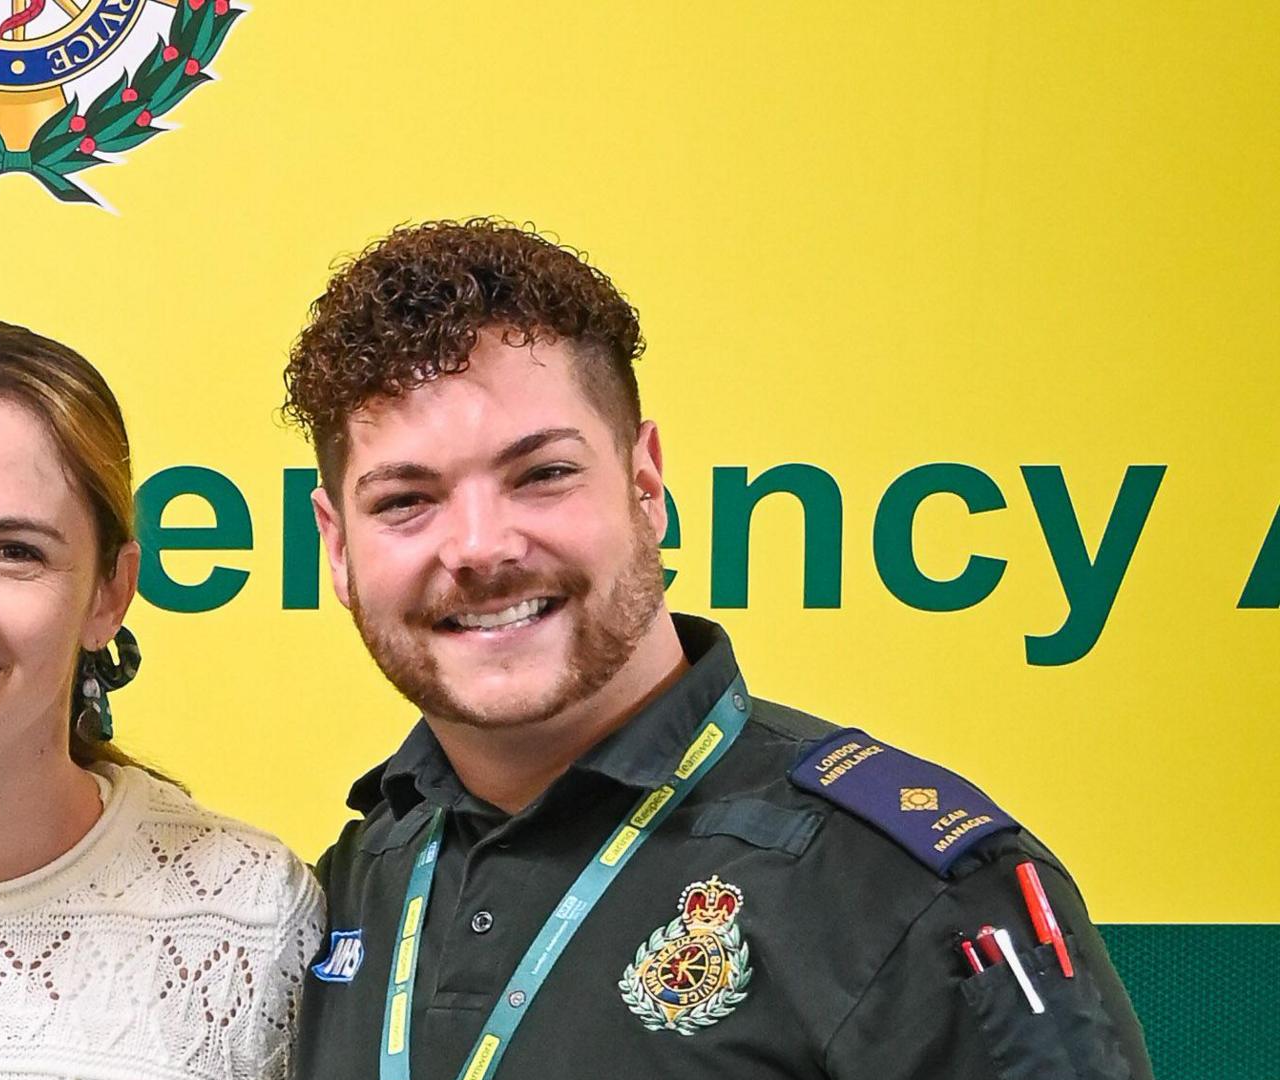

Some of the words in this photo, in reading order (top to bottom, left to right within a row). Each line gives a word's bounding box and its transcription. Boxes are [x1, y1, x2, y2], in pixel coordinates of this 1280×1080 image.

[814, 741, 862, 773] LONDON
[819, 744, 885, 787] AMBULANCE
[931, 808, 969, 832] TEAM
[933, 814, 994, 853] MANAGER
[323, 938, 362, 978] NHS
